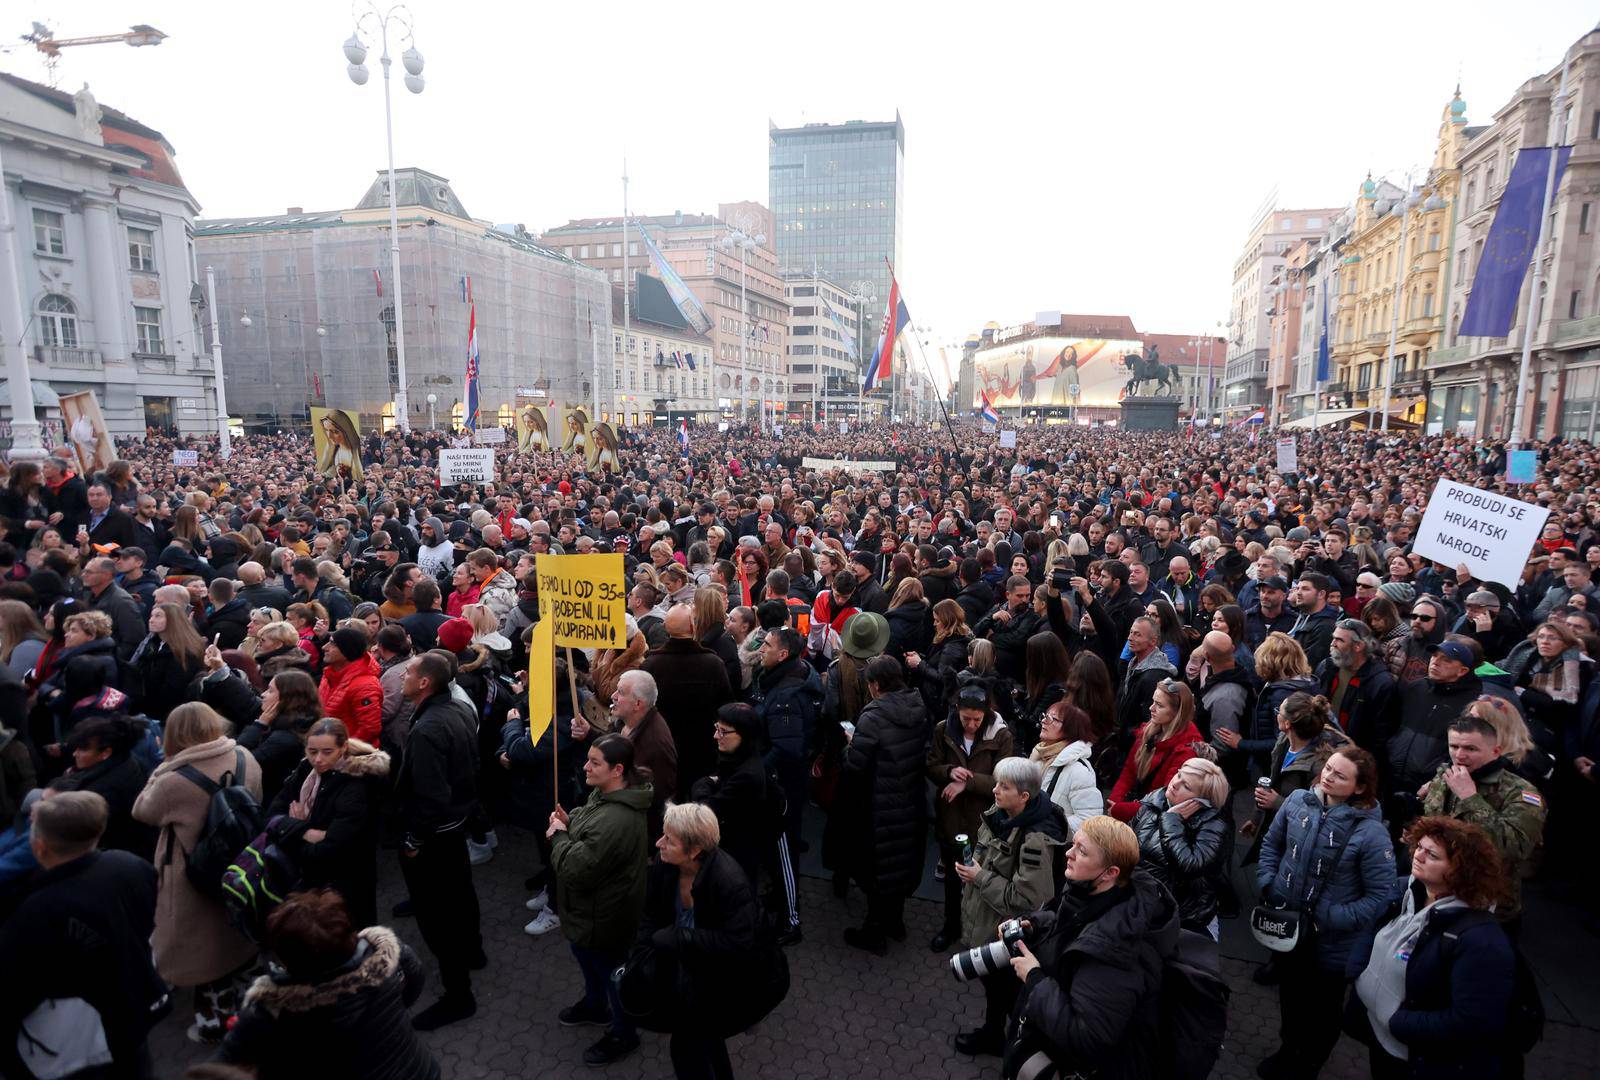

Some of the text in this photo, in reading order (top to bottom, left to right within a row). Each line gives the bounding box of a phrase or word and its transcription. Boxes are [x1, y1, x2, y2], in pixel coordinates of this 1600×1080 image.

[451, 474, 485, 482] TEMELJ
[1446, 487, 1527, 521] PROBUDI SE
[1443, 510, 1508, 541] HRVATSKI
[1436, 532, 1491, 561] NARODE
[560, 578, 571, 596] LI
[574, 580, 594, 598] OD
[597, 604, 610, 622] ILI
